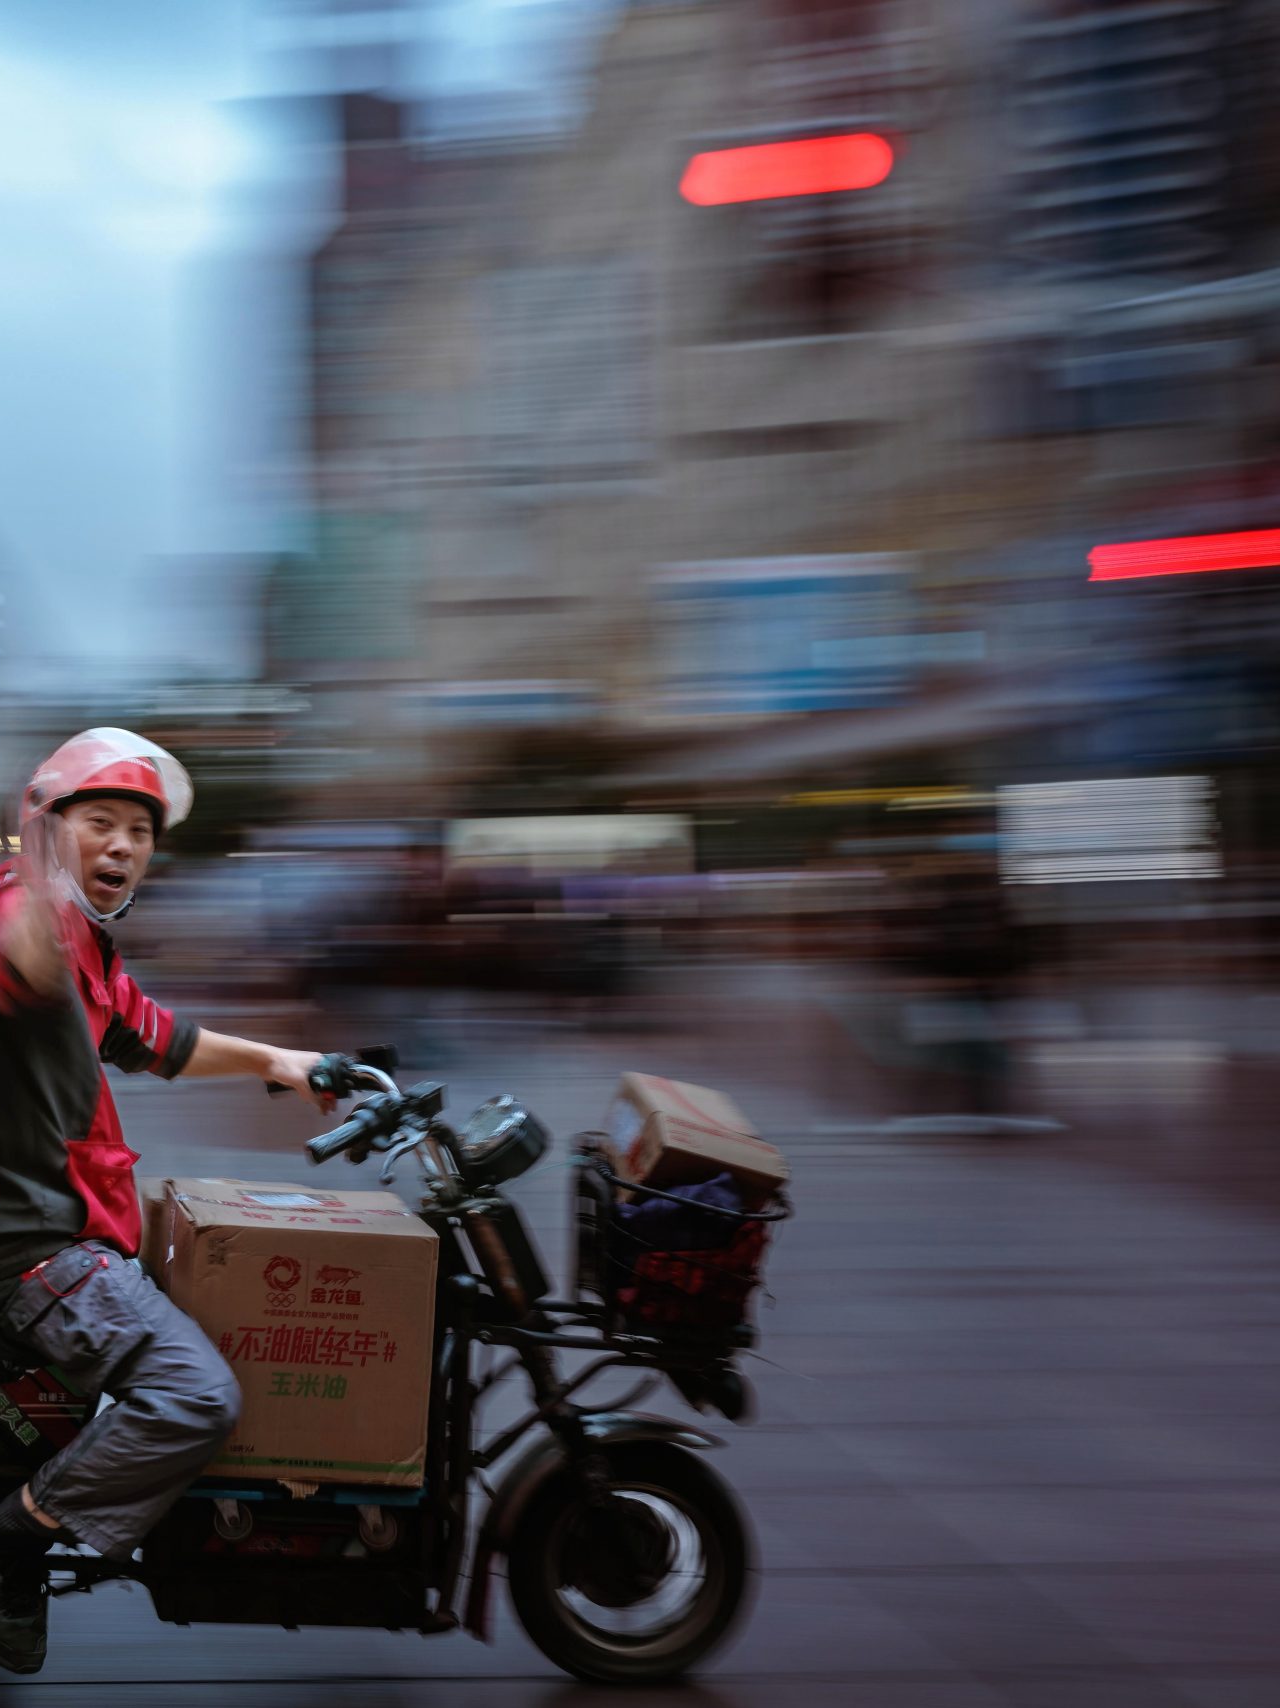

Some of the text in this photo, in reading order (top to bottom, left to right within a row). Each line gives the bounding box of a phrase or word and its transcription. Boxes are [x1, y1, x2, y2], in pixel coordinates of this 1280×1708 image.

[310, 1287, 362, 1306] 金龙鱼
[267, 1372, 348, 1400] 玉米油
